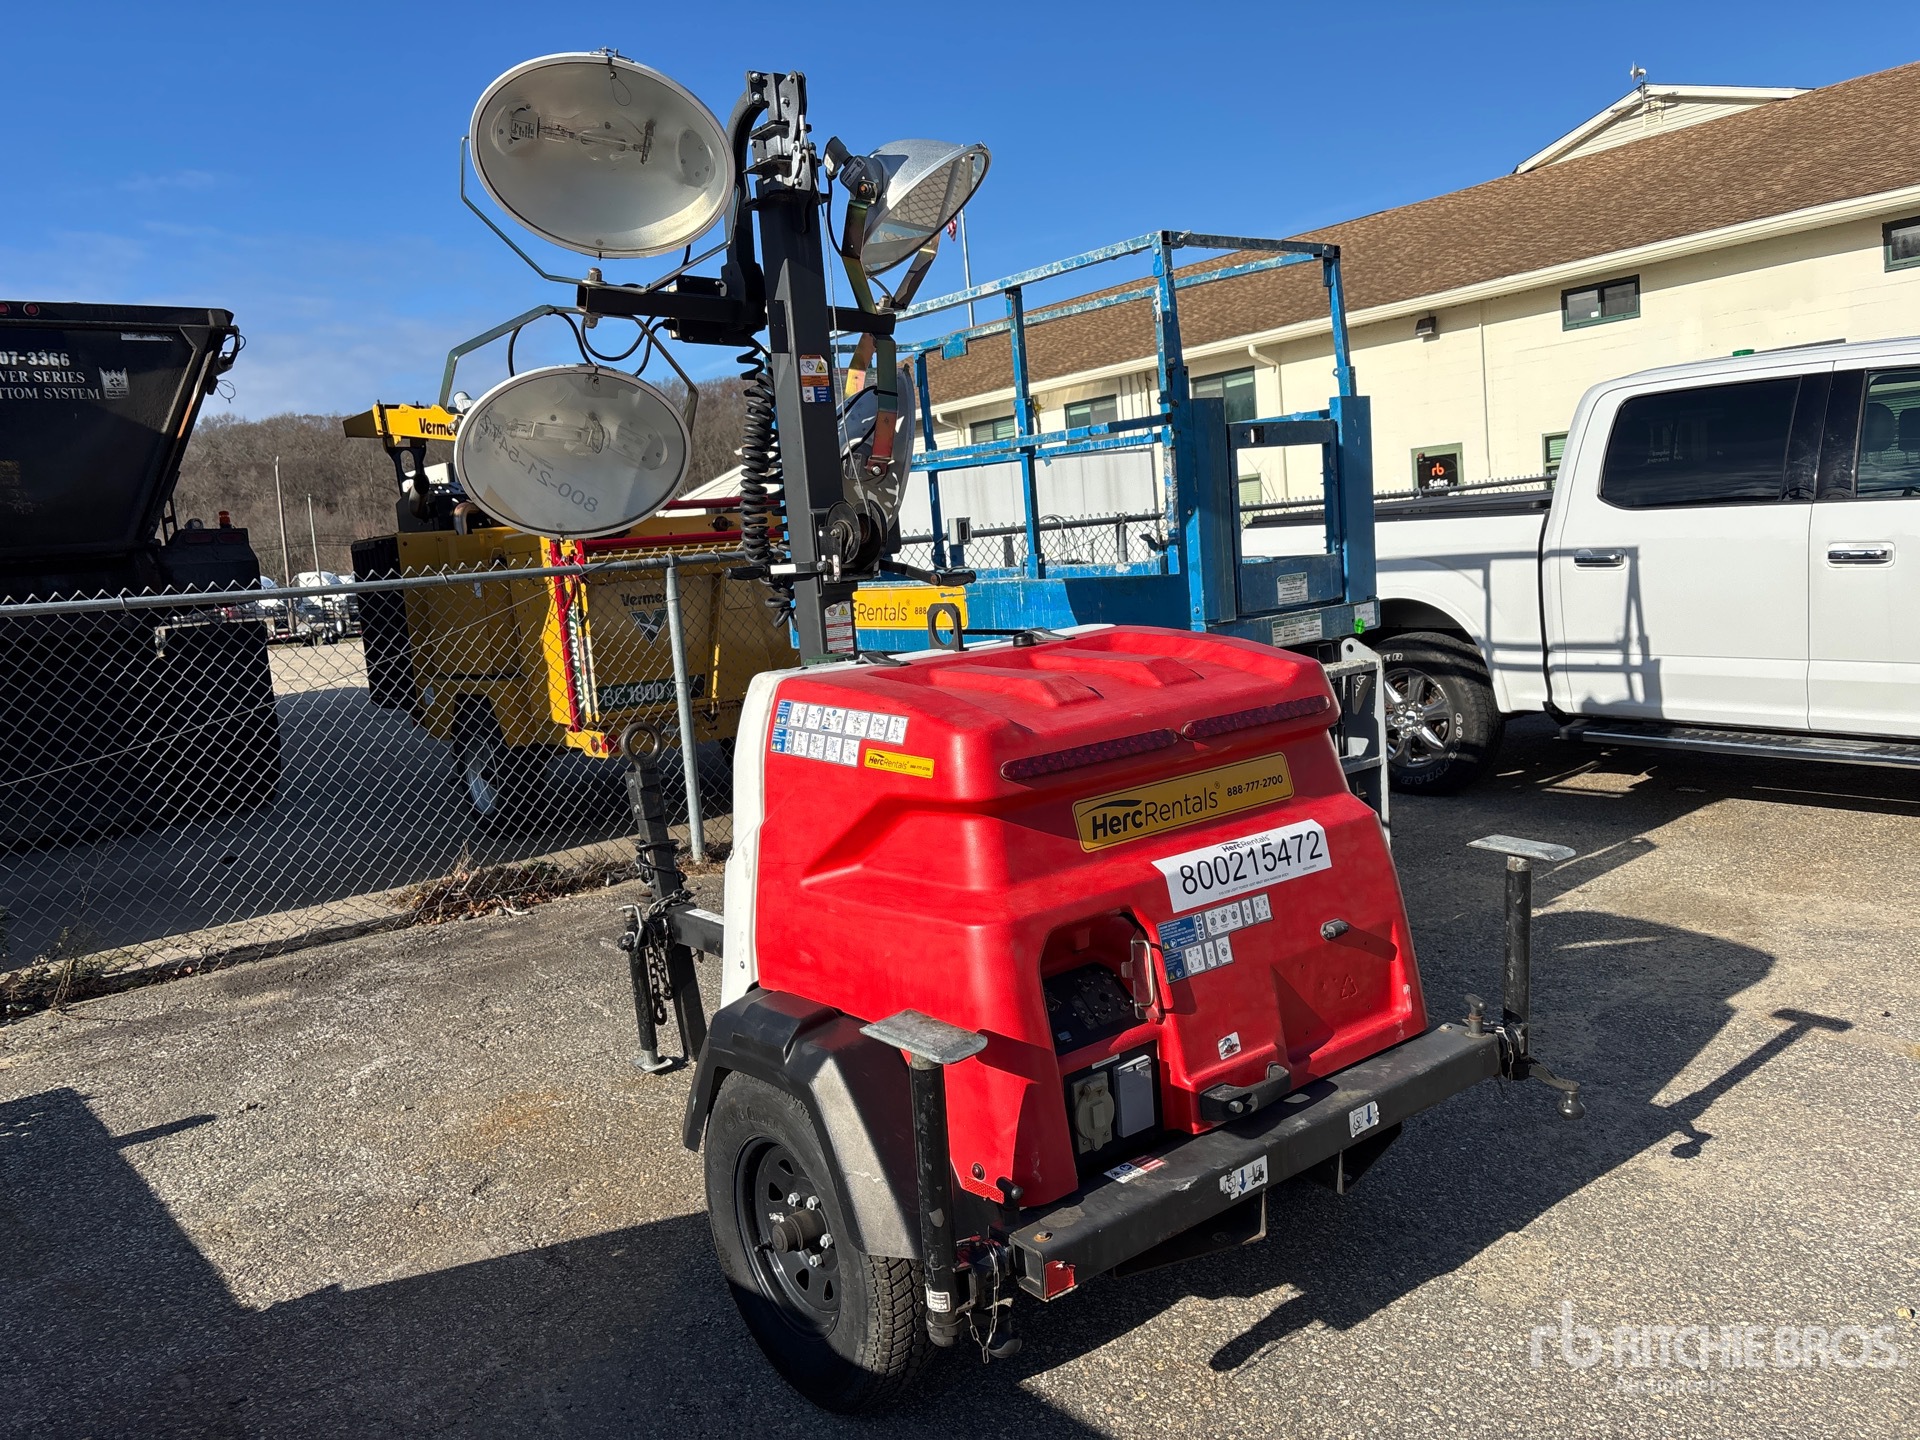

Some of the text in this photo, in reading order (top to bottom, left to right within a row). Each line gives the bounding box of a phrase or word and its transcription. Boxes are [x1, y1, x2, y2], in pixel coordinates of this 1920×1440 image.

[33, 371, 85, 383] SERIES
[44, 387, 100, 400] SYSTEM
[1431, 462, 1445, 476] rb
[1428, 478, 1449, 487] Sales
[1226, 774, 1284, 797] 888-777-2700
[1179, 830, 1323, 895] 800215472
